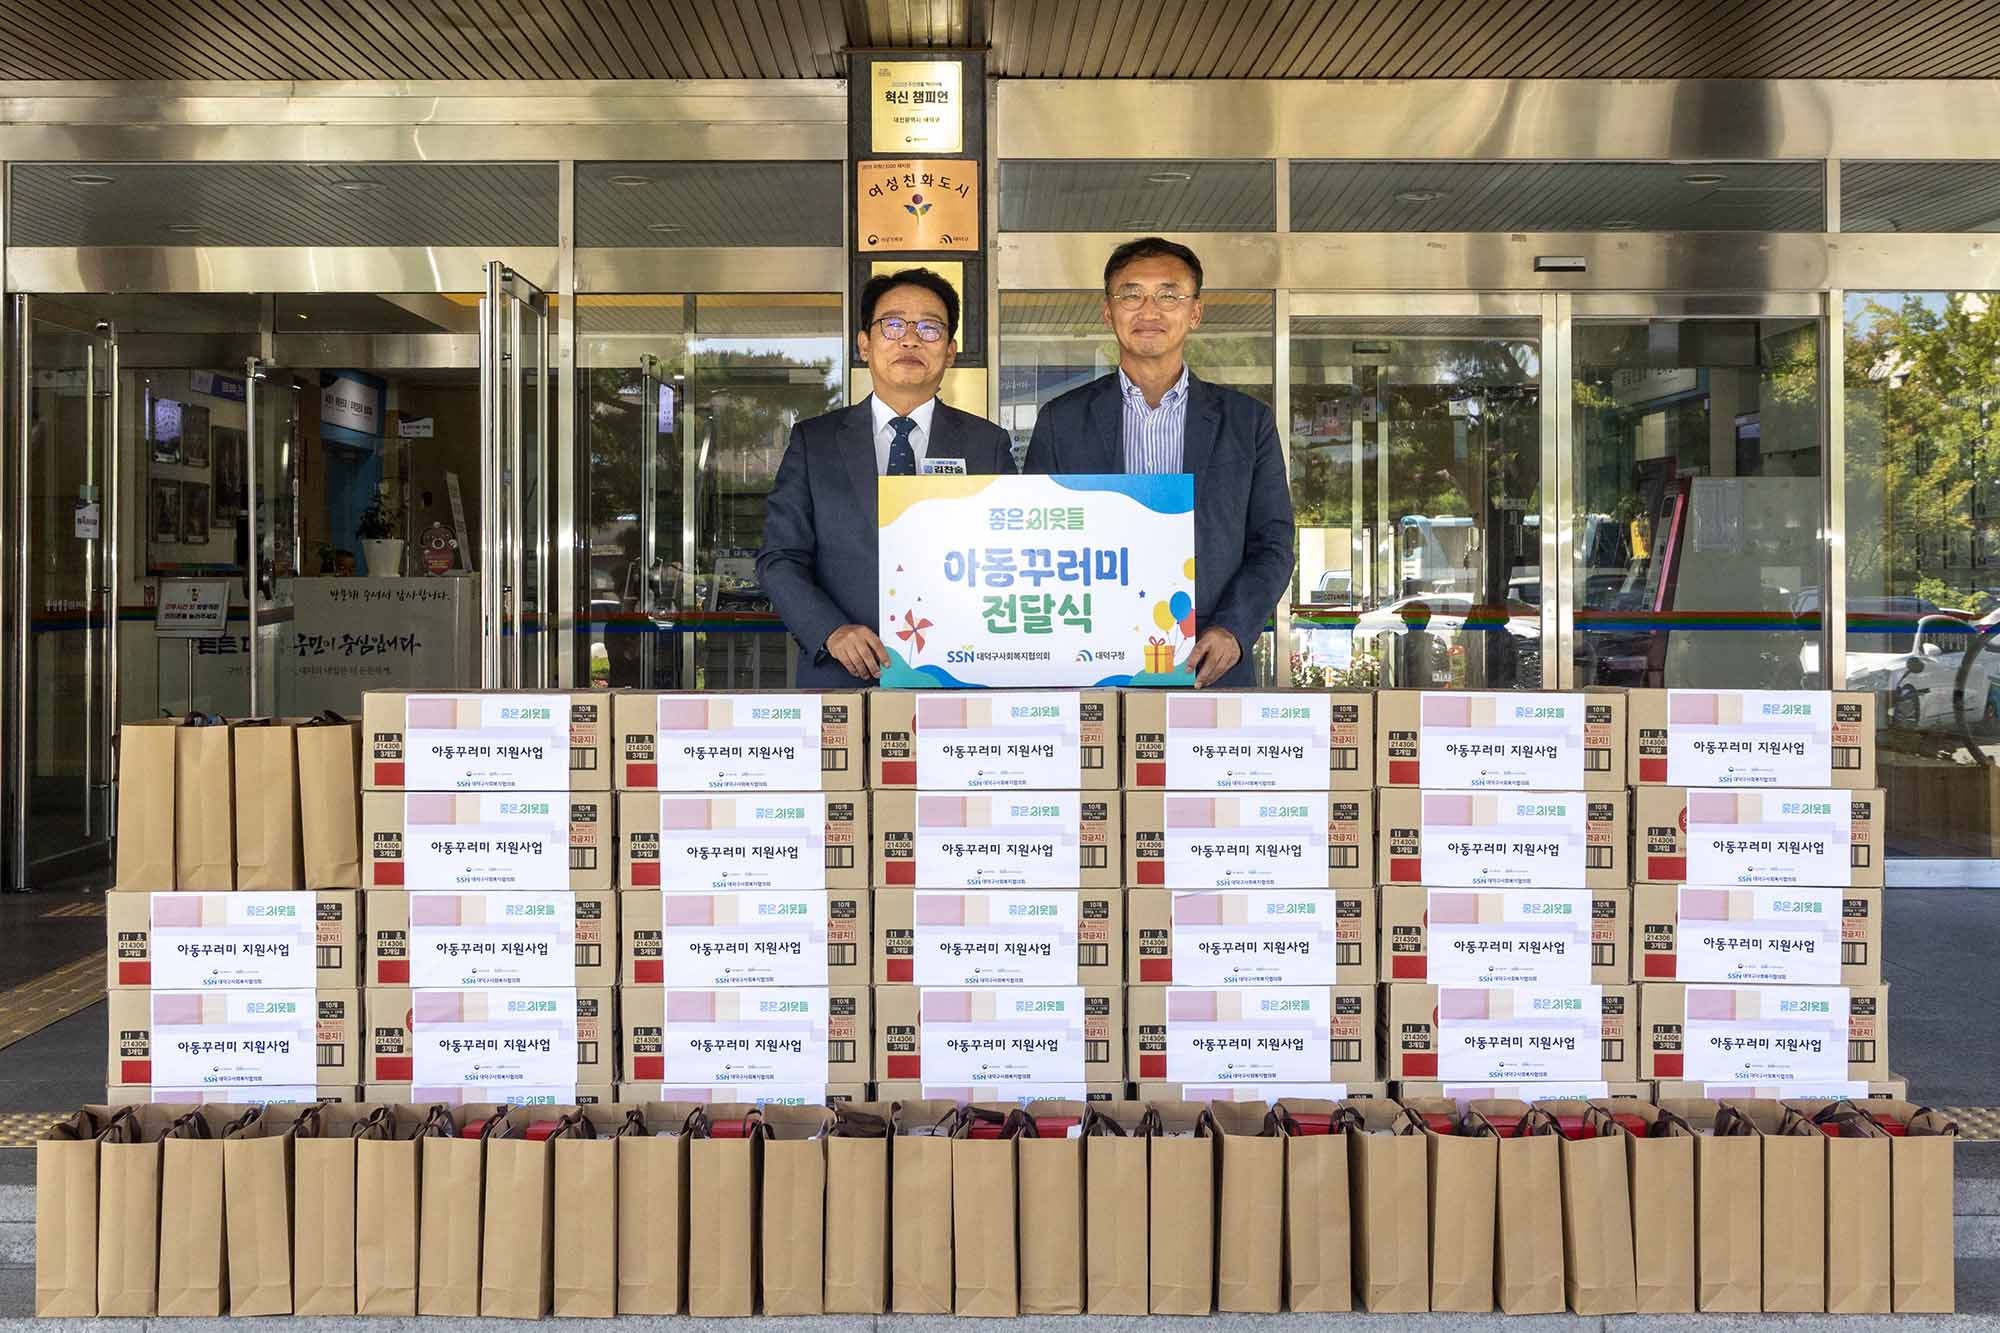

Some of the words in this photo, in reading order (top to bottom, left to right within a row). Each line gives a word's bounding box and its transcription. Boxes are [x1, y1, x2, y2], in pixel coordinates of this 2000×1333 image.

[885, 90, 909, 104] 혁신
[912, 90, 949, 104] 챔피언
[868, 173, 969, 198] 여성친화도시
[944, 547, 1129, 587] 아동꾸러미
[982, 593, 1093, 634] 전달식
[947, 650, 975, 663] SSN
[976, 651, 1051, 662] 대덕구사회복지협의회
[1095, 651, 1125, 661] 대덕구청
[432, 746, 490, 759] 아동꾸러미
[497, 747, 542, 759] 지원사업
[684, 747, 741, 760] 아동꾸러미
[748, 747, 794, 759] 지원사업
[943, 745, 1000, 759] 아동꾸러미
[1008, 745, 1053, 757] 지원사업
[1193, 746, 1250, 758] 아동꾸러미
[1257, 746, 1303, 758] 지원사업
[1447, 744, 1504, 758] 아동꾸러미
[1511, 746, 1557, 758] 지원사업
[1694, 742, 1751, 754] 아동꾸러미
[1758, 742, 1804, 755] 지원사업
[431, 842, 489, 855] 아동꾸러미
[496, 842, 542, 854] 지원사업
[687, 847, 745, 860] 아동꾸러미
[752, 846, 797, 859] 지원사업
[942, 844, 1000, 857] 아동꾸러미
[1007, 844, 1052, 857] 지원사업
[1191, 845, 1249, 858] 아동꾸러미
[1256, 845, 1301, 857] 지원사업
[1448, 843, 1506, 856] 아동꾸러미
[1513, 844, 1559, 856] 지원사업
[1713, 841, 1771, 854] 아동꾸러미
[1778, 842, 1823, 854] 지원사업
[178, 944, 236, 957] 아동꾸러미
[243, 944, 288, 956] 지원사업
[437, 944, 495, 956] 아동꾸러미
[502, 943, 547, 955] 지원사업
[690, 943, 748, 956] 아동꾸러미
[755, 942, 800, 955] 지원사업
[940, 943, 998, 956] 아동꾸러미
[1005, 943, 1050, 956] 지원사업
[1199, 942, 1256, 955] 아동꾸러미
[1264, 942, 1309, 954] 지원사업
[1454, 941, 1512, 954] 아동꾸러미
[1519, 941, 1564, 954] 지원사업
[1704, 938, 1762, 951] 아동꾸러미
[1769, 940, 1814, 953] 지원사업
[178, 1041, 236, 1055] 아동꾸러미
[243, 1041, 289, 1053] 지원사업
[440, 1040, 497, 1053] 아동꾸러미
[504, 1039, 550, 1052] 지원사업
[691, 1040, 748, 1052] 아동꾸러미
[755, 1040, 801, 1052] 지원사업
[947, 1040, 1005, 1052] 아동꾸러미
[1012, 1039, 1057, 1052] 지원사업
[1193, 1038, 1251, 1052] 아동꾸러미
[1257, 1038, 1303, 1051] 지원사업
[1465, 1037, 1522, 1049] 아동꾸러미
[1529, 1037, 1574, 1050] 지원사업
[1711, 1038, 1768, 1050] 아동꾸러미
[1776, 1039, 1821, 1052] 지원사업
